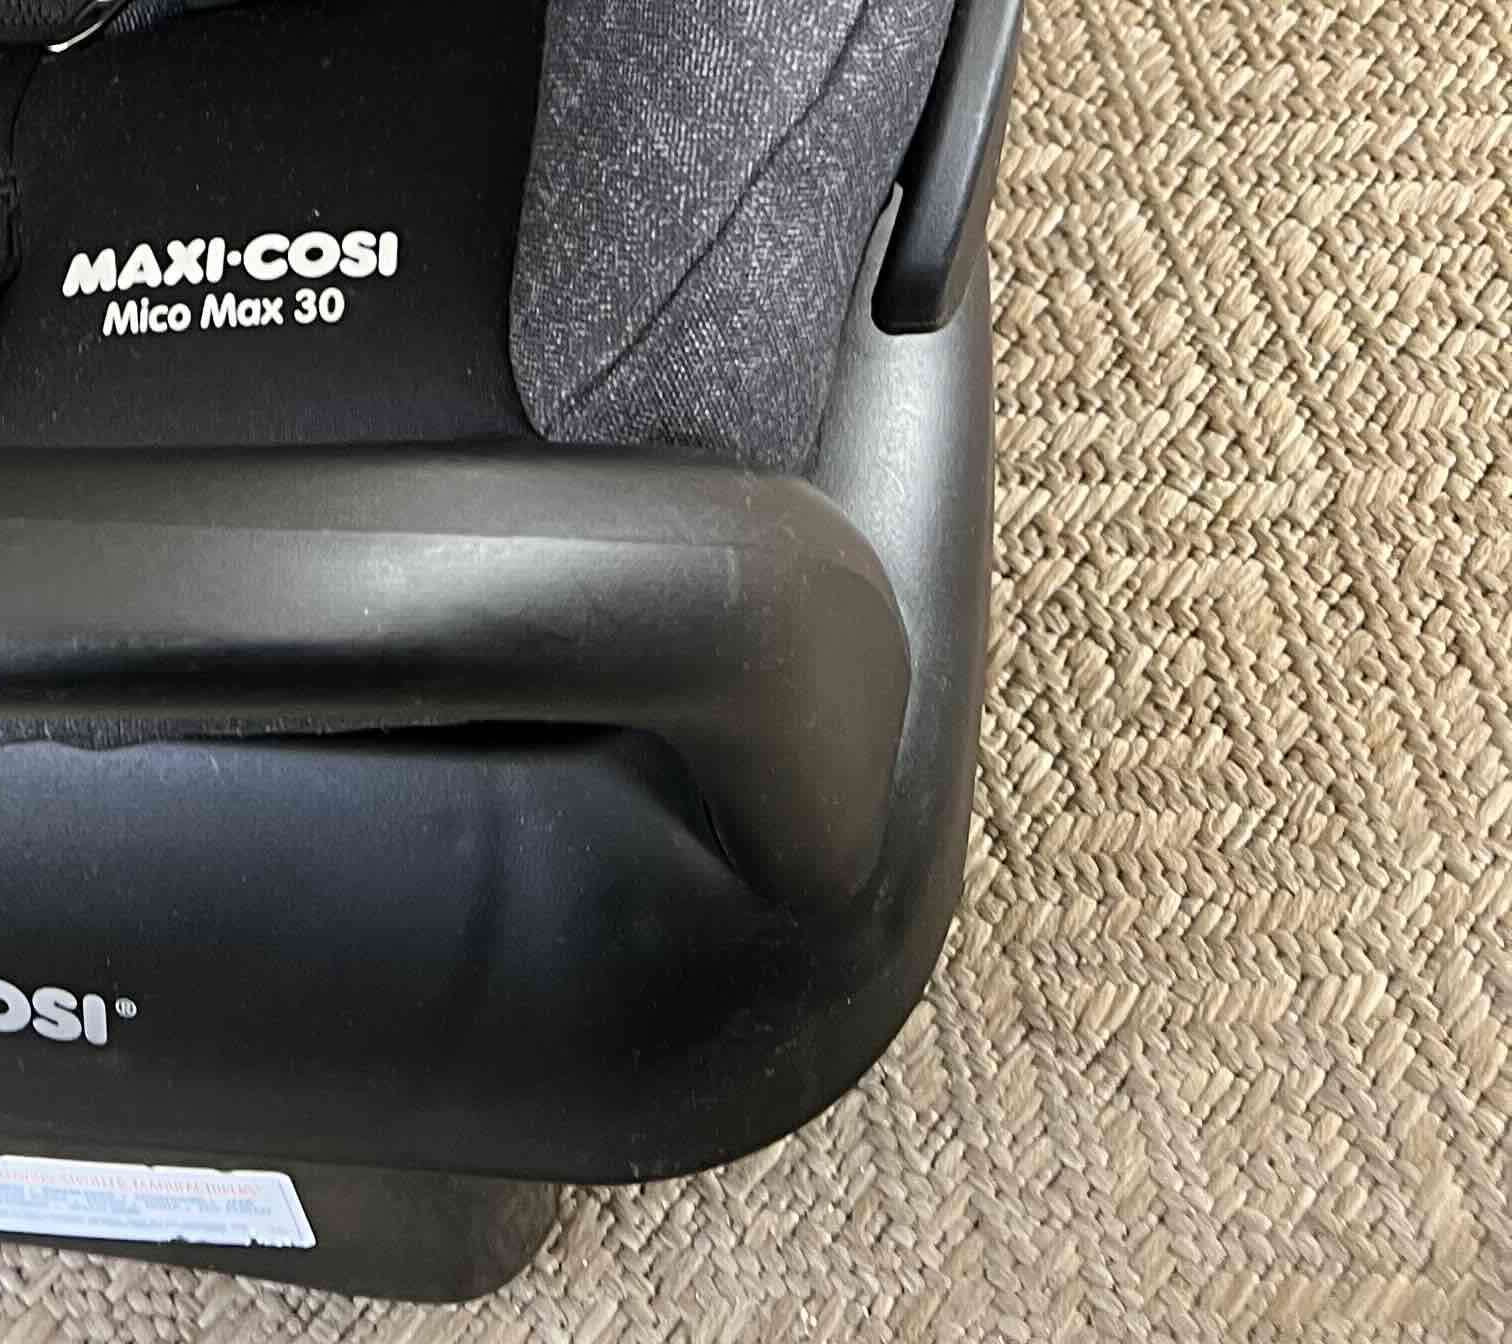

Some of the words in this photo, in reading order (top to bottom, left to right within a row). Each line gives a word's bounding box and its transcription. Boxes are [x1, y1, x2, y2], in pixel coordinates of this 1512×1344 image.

[102, 296, 192, 337] Mico
[200, 291, 285, 330] Max
[293, 286, 346, 325] 30
